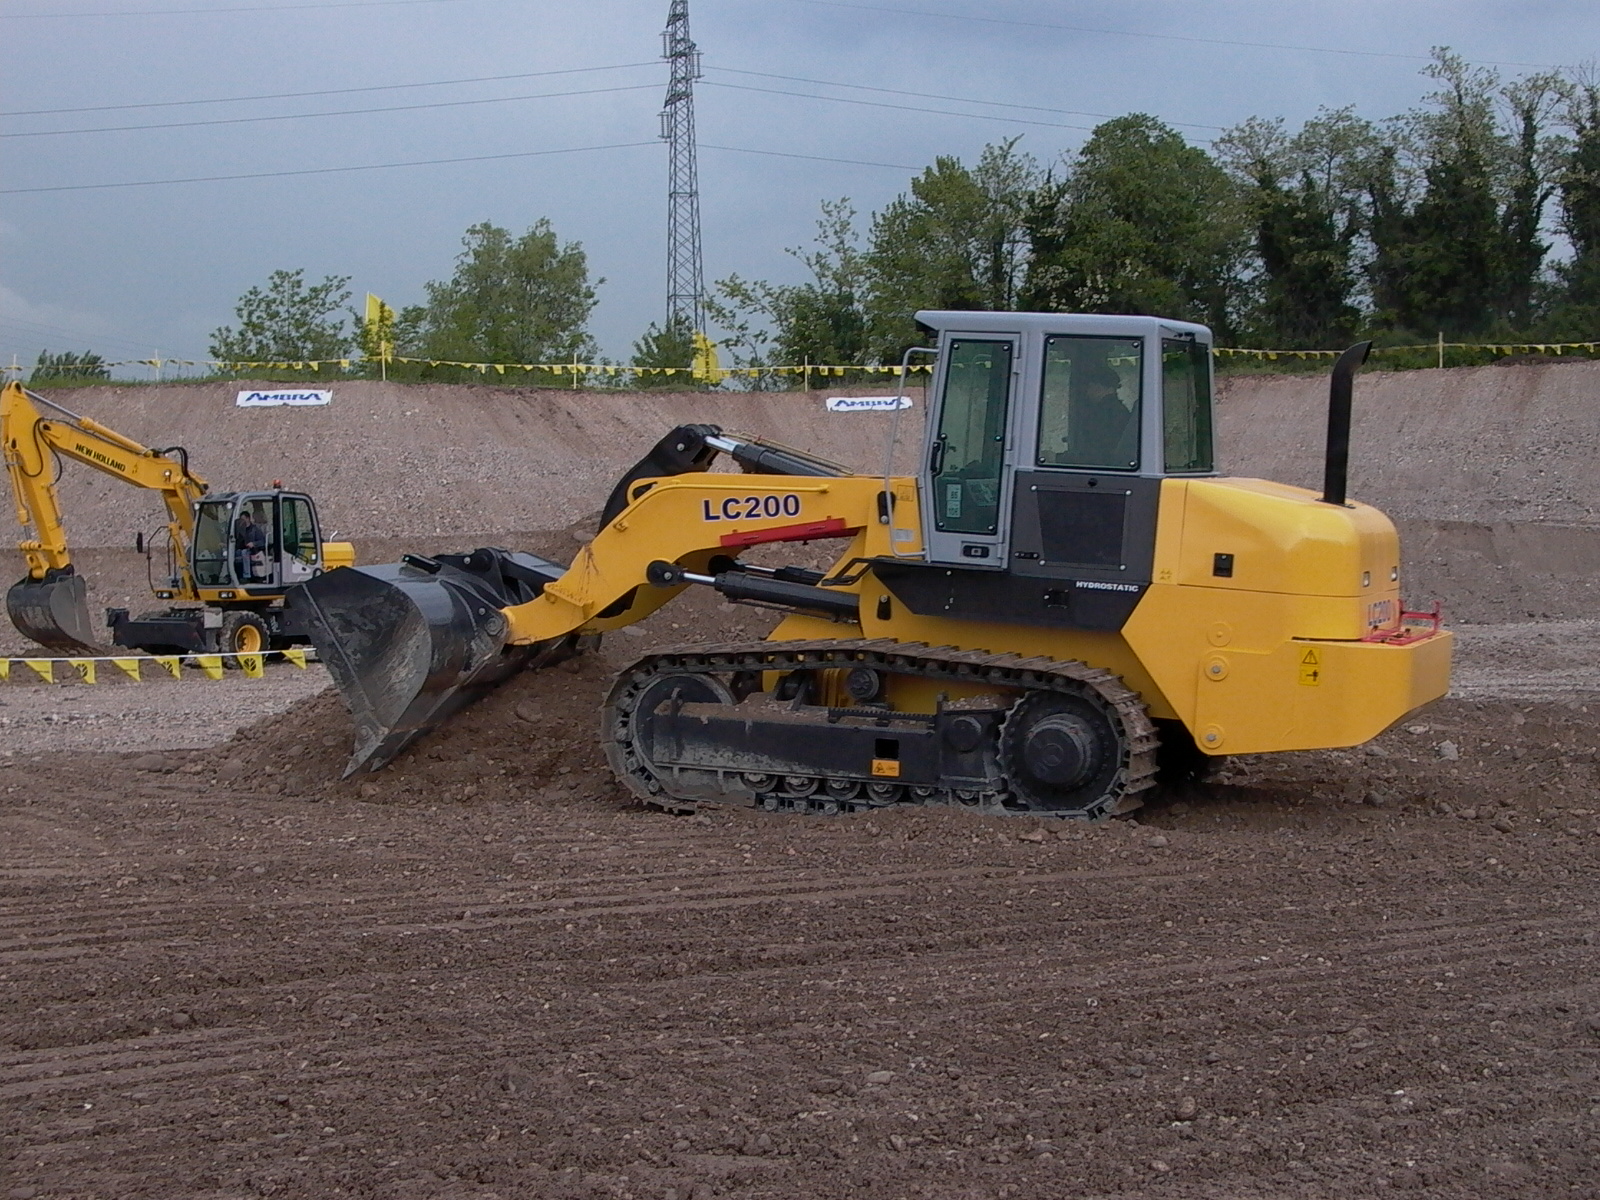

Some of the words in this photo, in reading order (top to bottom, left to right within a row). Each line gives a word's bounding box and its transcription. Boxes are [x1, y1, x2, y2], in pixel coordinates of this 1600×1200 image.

[245, 392, 322, 402] AMBRA
[75, 443, 93, 457] NEW
[92, 451, 126, 472] HOLLAND
[703, 494, 800, 520] LC200
[1076, 581, 1139, 592] HYDROSTATIC
